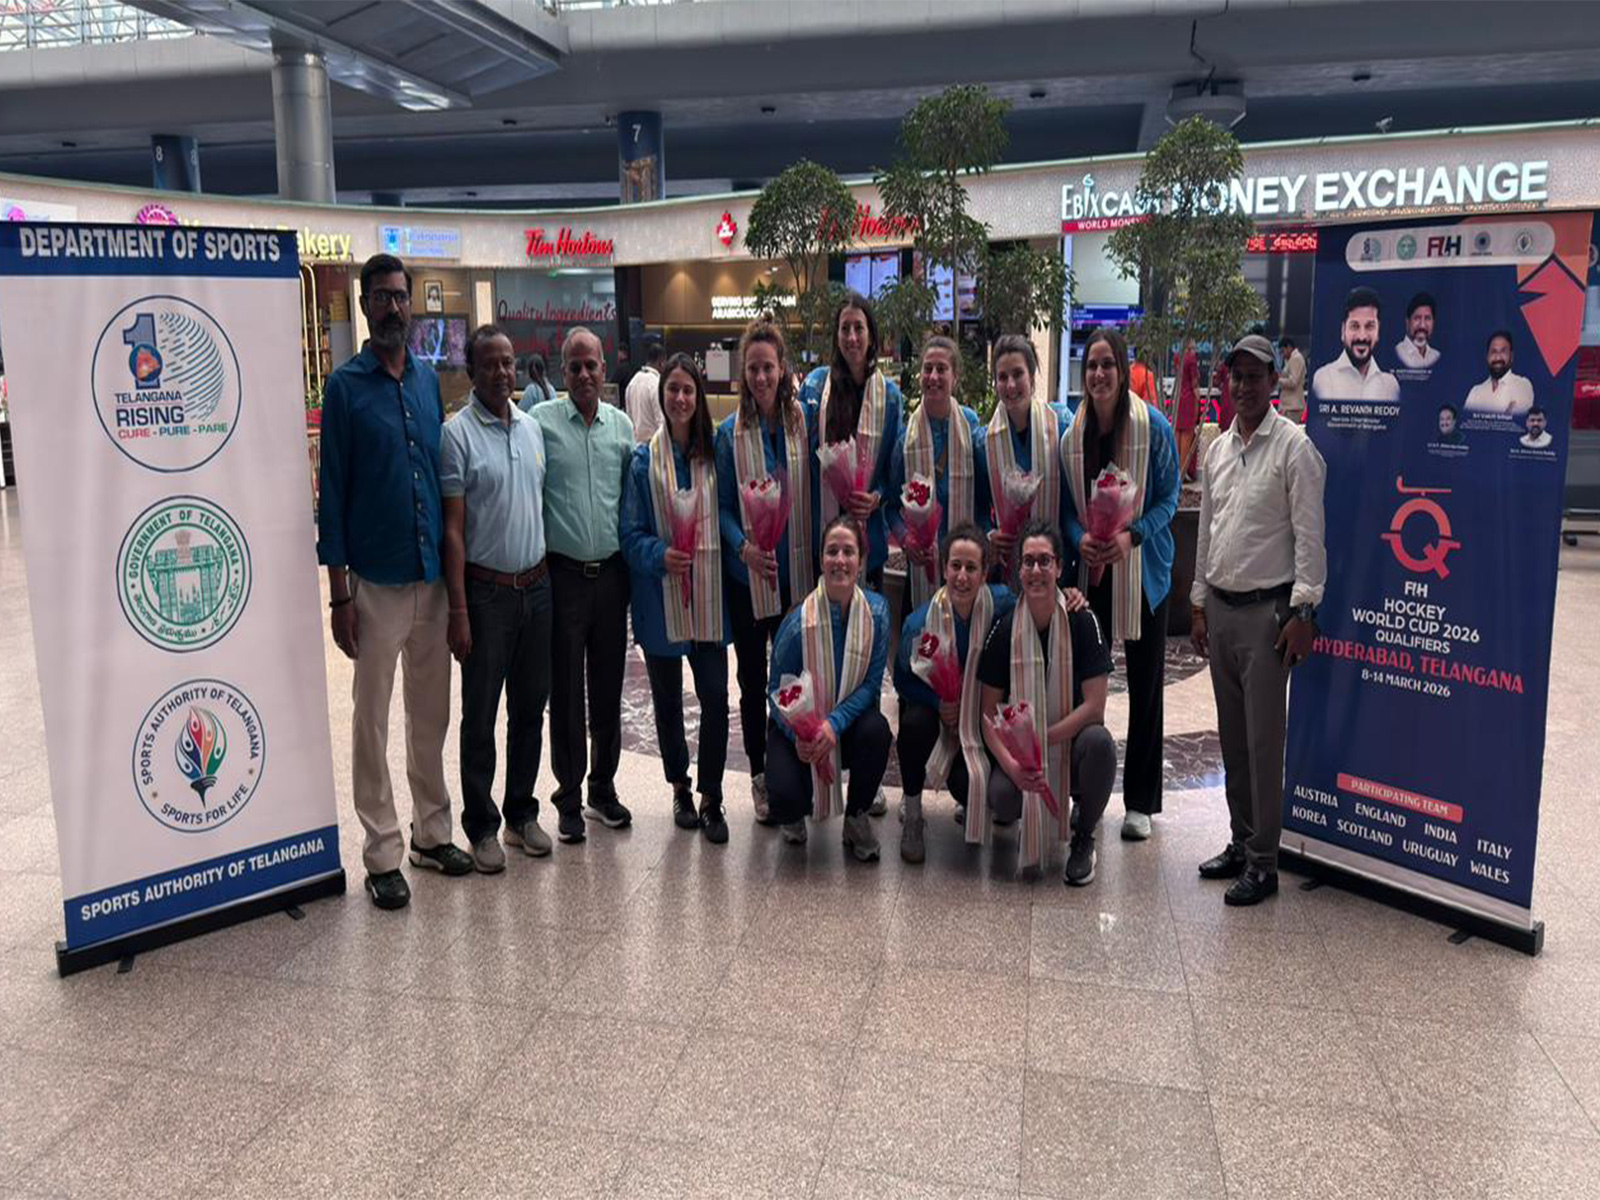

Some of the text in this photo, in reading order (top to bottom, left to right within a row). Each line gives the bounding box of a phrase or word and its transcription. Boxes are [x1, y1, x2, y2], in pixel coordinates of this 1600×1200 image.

[632, 124, 642, 143] 7
[155, 145, 163, 161] 8
[1314, 161, 1548, 211] EXCHANGE
[1077, 220, 1108, 230] WORLD
[19, 227, 280, 261] DEPARTMENT OF SPORTS
[524, 227, 614, 256] Tim Hortons
[115, 391, 182, 402] TELANGANA
[1373, 406, 1400, 416] REDDY
[116, 406, 185, 426] RISING
[118, 428, 151, 439] CURE
[159, 425, 191, 436] PURE
[198, 423, 228, 433] PARE
[129, 510, 239, 579] GOVERNMENT OF TELANGANA
[1384, 598, 1446, 621] HOCKEY
[1352, 608, 1480, 644] WORLD CUP 2026
[1375, 630, 1451, 654] QUALIFIERS
[1312, 636, 1524, 695] HYDERABAD, TELANGANA
[1361, 668, 1451, 697] 8-14 MARCH 2026
[141, 687, 259, 786] SPORTS AUTHORITY OF TELANGANA
[161, 783, 249, 824] SPORTS FOR LIFE
[1351, 780, 1448, 816] PARTICIPATING TEAM
[1294, 784, 1512, 860] AUSTRIA ENGLAND INDIA ITALY
[1292, 805, 1511, 884] KOREA SCOTLAND URUGUAY WALES
[80, 837, 325, 921] SPORTS AUTHORITY OF TELANGANA
